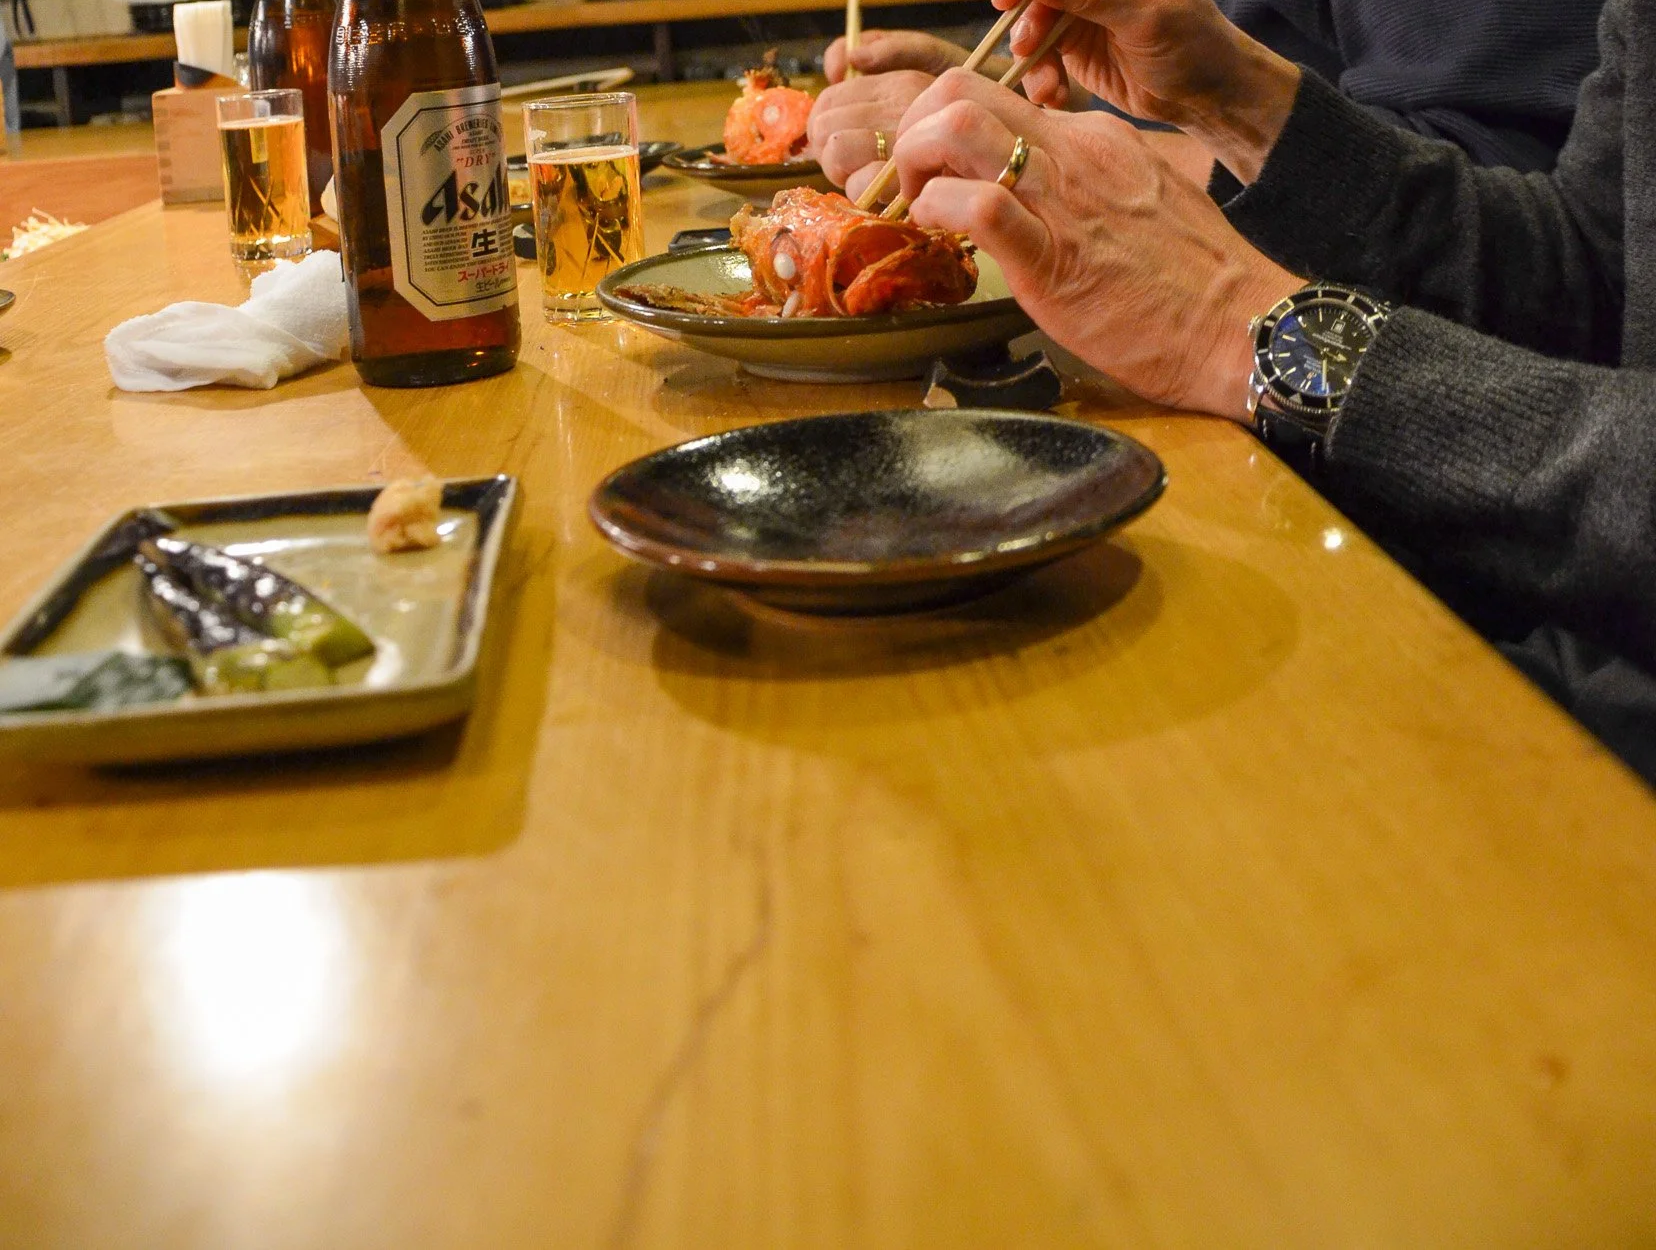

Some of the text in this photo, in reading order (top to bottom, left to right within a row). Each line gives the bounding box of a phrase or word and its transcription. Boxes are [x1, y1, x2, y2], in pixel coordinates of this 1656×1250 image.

[434, 130, 455, 152] ASAHI
[471, 228, 499, 258] 生
[457, 261, 509, 283] スーパードライ
